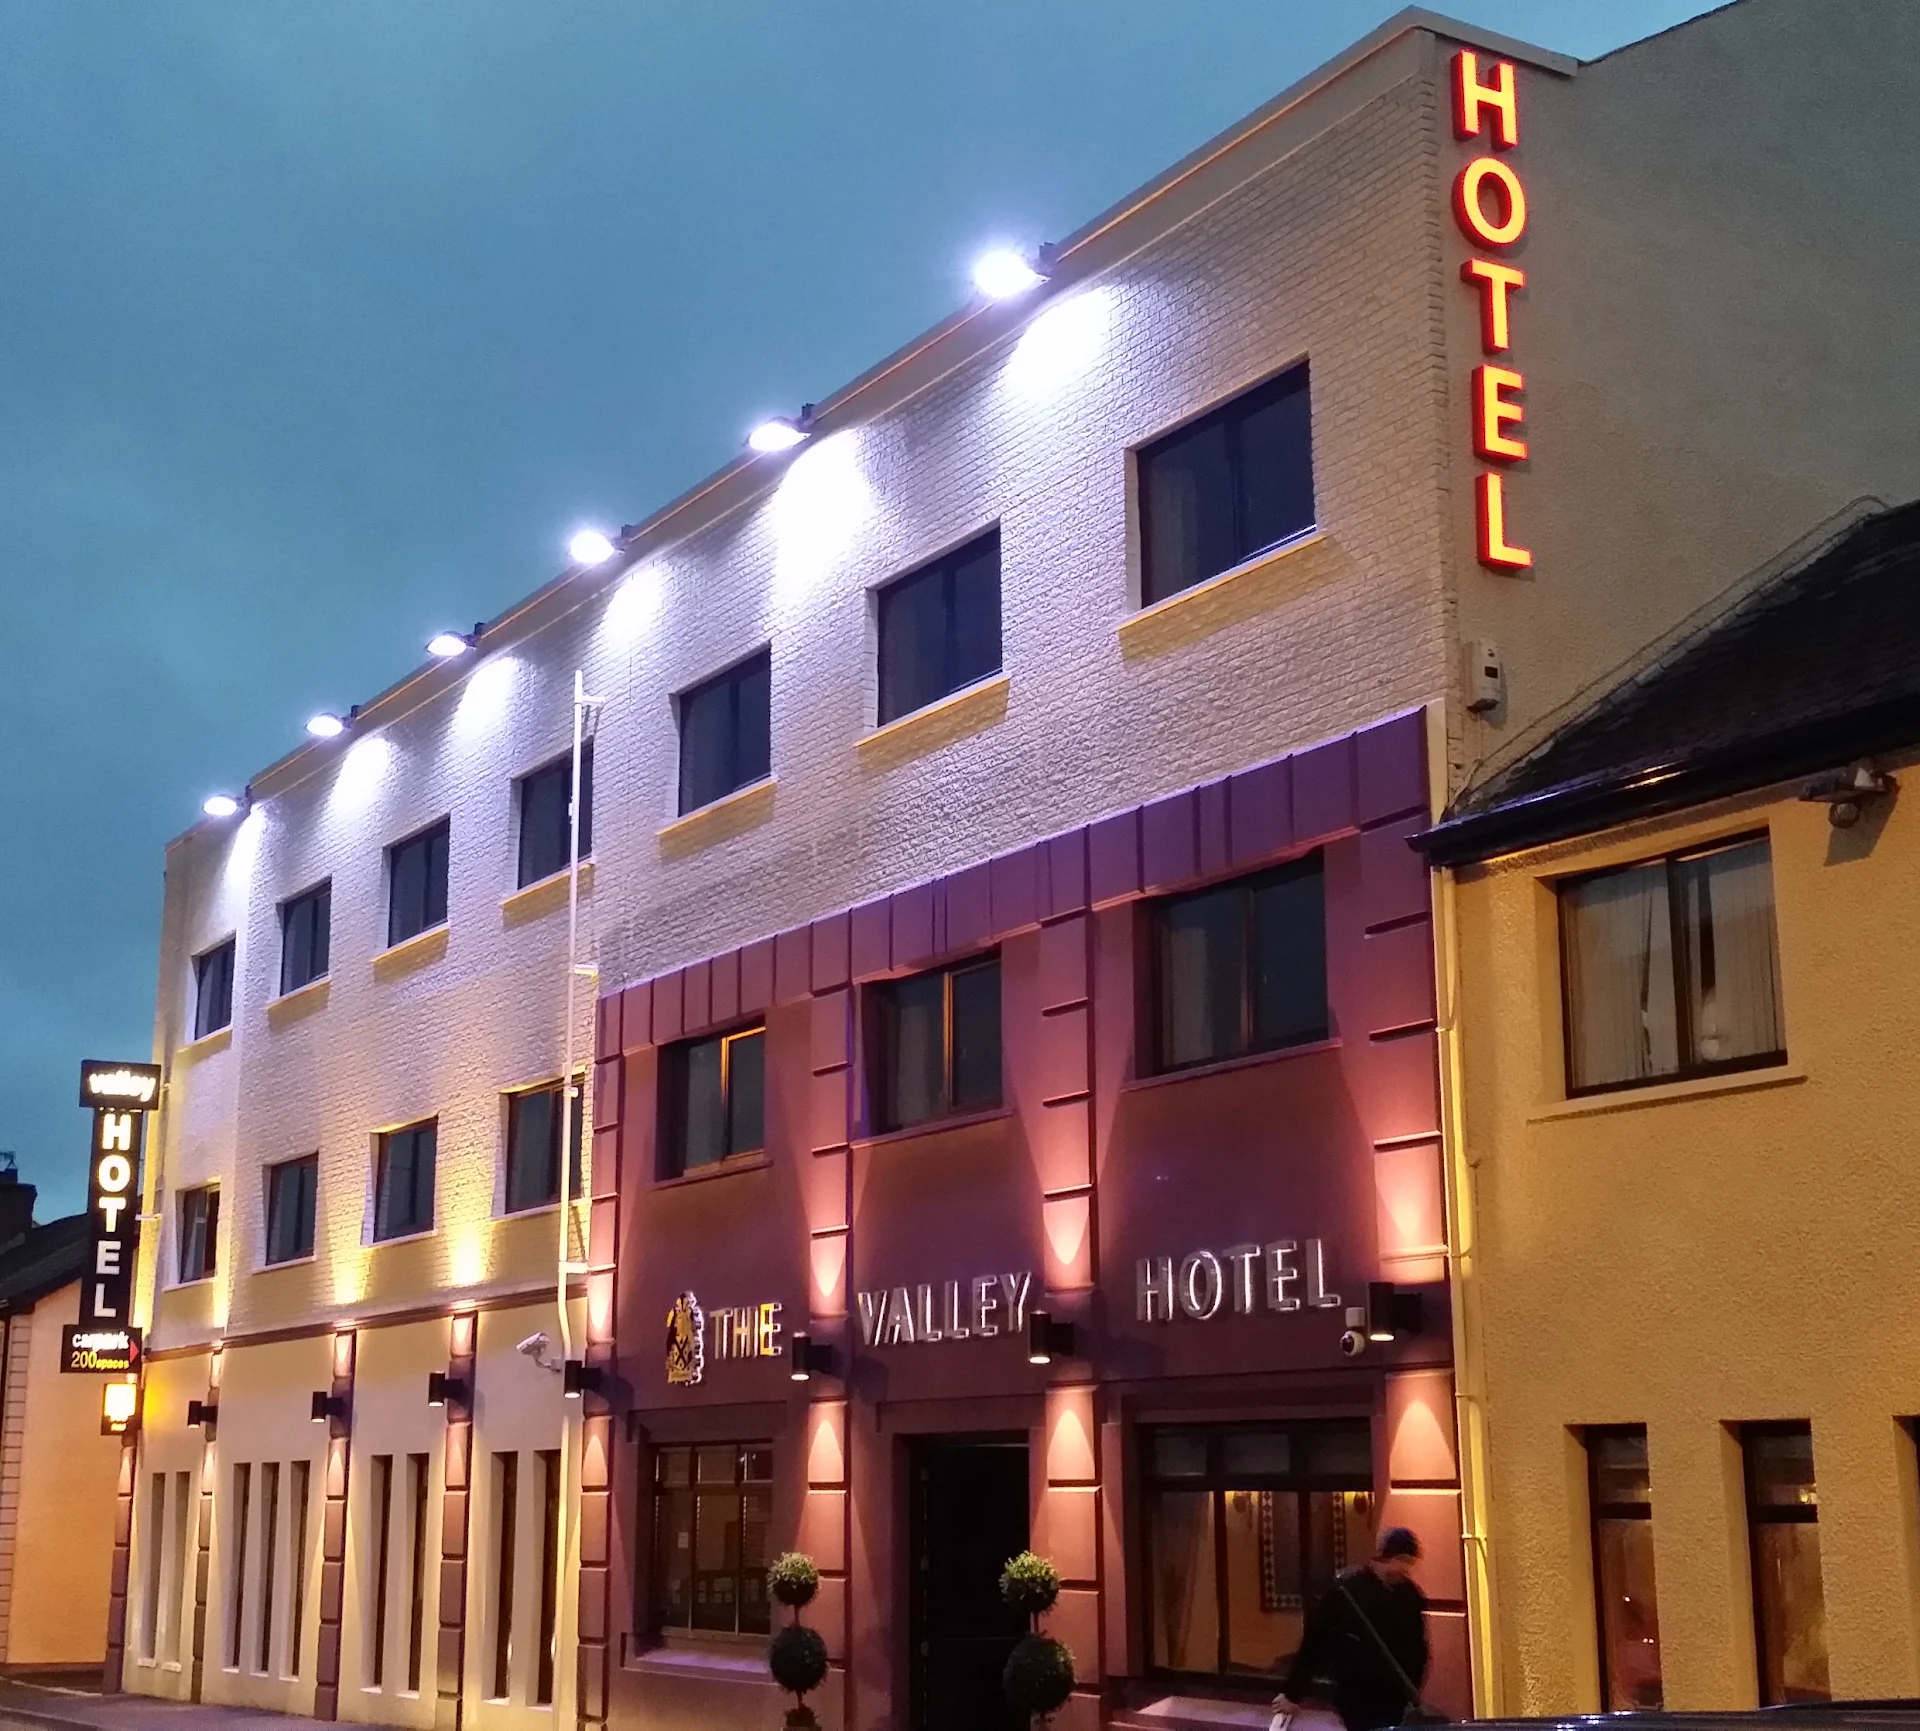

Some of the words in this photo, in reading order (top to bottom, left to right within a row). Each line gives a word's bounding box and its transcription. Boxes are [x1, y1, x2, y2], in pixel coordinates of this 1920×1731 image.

[1451, 48, 1533, 569] HOTEL
[93, 1112, 132, 1319] HOTEL
[709, 1301, 783, 1360] THE
[857, 1270, 1033, 1347] VALLEY
[1135, 1238, 1342, 1323] HOTEL
